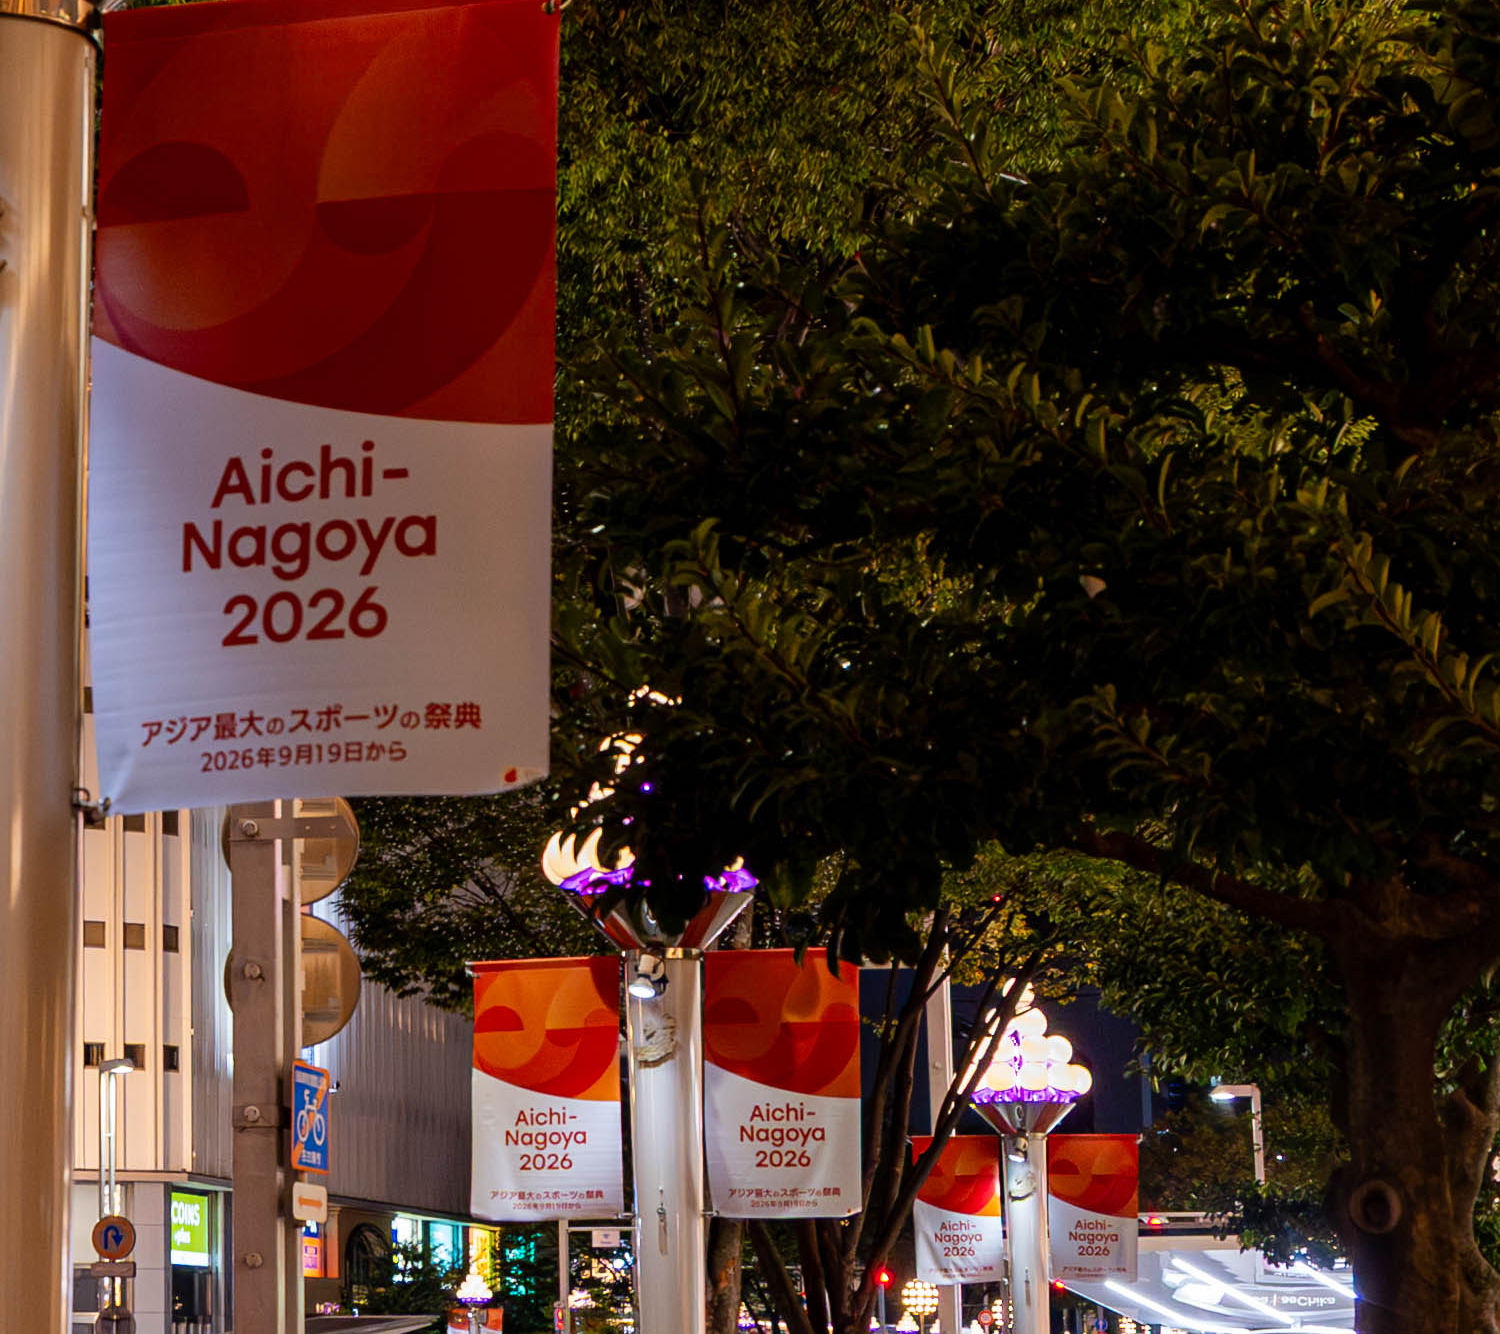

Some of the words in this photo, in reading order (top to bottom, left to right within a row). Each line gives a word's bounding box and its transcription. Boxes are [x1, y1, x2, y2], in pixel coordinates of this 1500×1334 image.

[210, 439, 409, 509] Aichi-
[182, 514, 437, 582] Nagoya
[221, 586, 388, 647] 2026
[141, 701, 483, 747] アジア最大のスポーツの祭典
[200, 741, 407, 772] 2026年9月19日から
[515, 1106, 578, 1127] Aichi-
[749, 1101, 816, 1122] Aichi-
[504, 1130, 587, 1150] Nagoya
[739, 1125, 826, 1147] Nagoya
[519, 1153, 574, 1171] 2026
[755, 1149, 812, 1168] 2026
[939, 1219, 977, 1232] Aichi-
[1074, 1218, 1113, 1231] Aichi-
[933, 1232, 983, 1245] Nagoya
[1068, 1231, 1119, 1244] Nagoya
[943, 1245, 976, 1258] 2026
[1077, 1245, 1110, 1257] 2026
